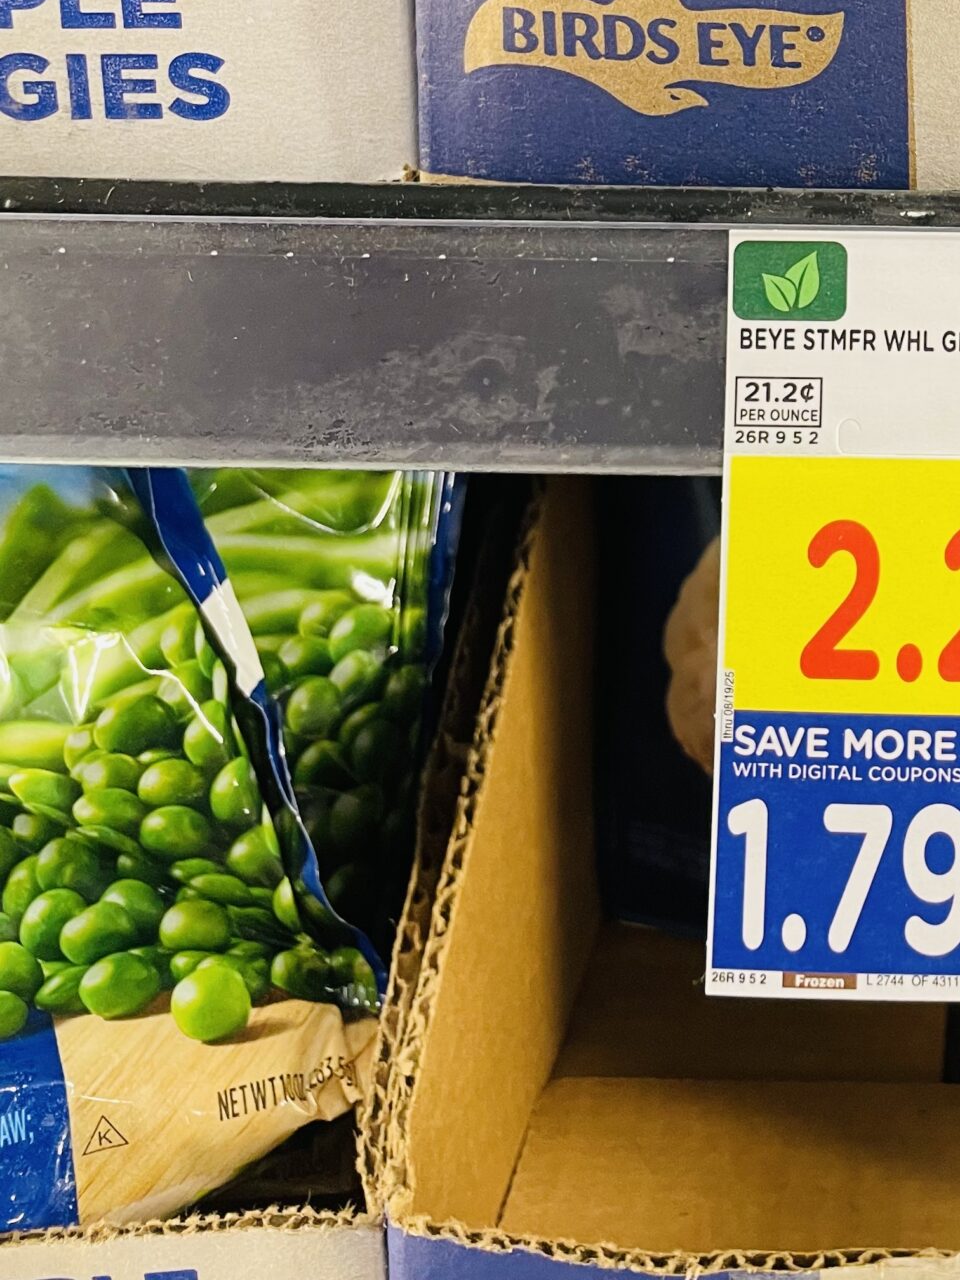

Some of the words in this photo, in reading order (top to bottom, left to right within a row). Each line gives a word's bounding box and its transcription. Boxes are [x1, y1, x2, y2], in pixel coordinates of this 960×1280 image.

[501, 6, 680, 65] BIRDS
[739, 327, 796, 350] BEYE
[803, 328, 876, 351] STMFR
[884, 329, 935, 352] WHL
[743, 381, 815, 403] 21.2¢
[739, 408, 765, 421] PER
[770, 408, 819, 422] OUNCE
[735, 430, 769, 444] 26R
[775, 430, 786, 444] 9
[792, 431, 802, 444] 5
[808, 431, 819, 445] 2
[733, 724, 830, 758] SAVE
[843, 727, 958, 762] MORE
[732, 761, 782, 779] WITH
[788, 763, 863, 781] DIGITAL
[711, 971, 735, 983] 26R
[738, 972, 746, 984] 9
[749, 972, 756, 984] 5
[760, 973, 767, 985] 2
[795, 974, 845, 989] Frozen
[876, 974, 904, 986] 2744
[911, 975, 928, 986] OF
[931, 975, 959, 987] 4311
[217, 1084, 248, 1121] NET
